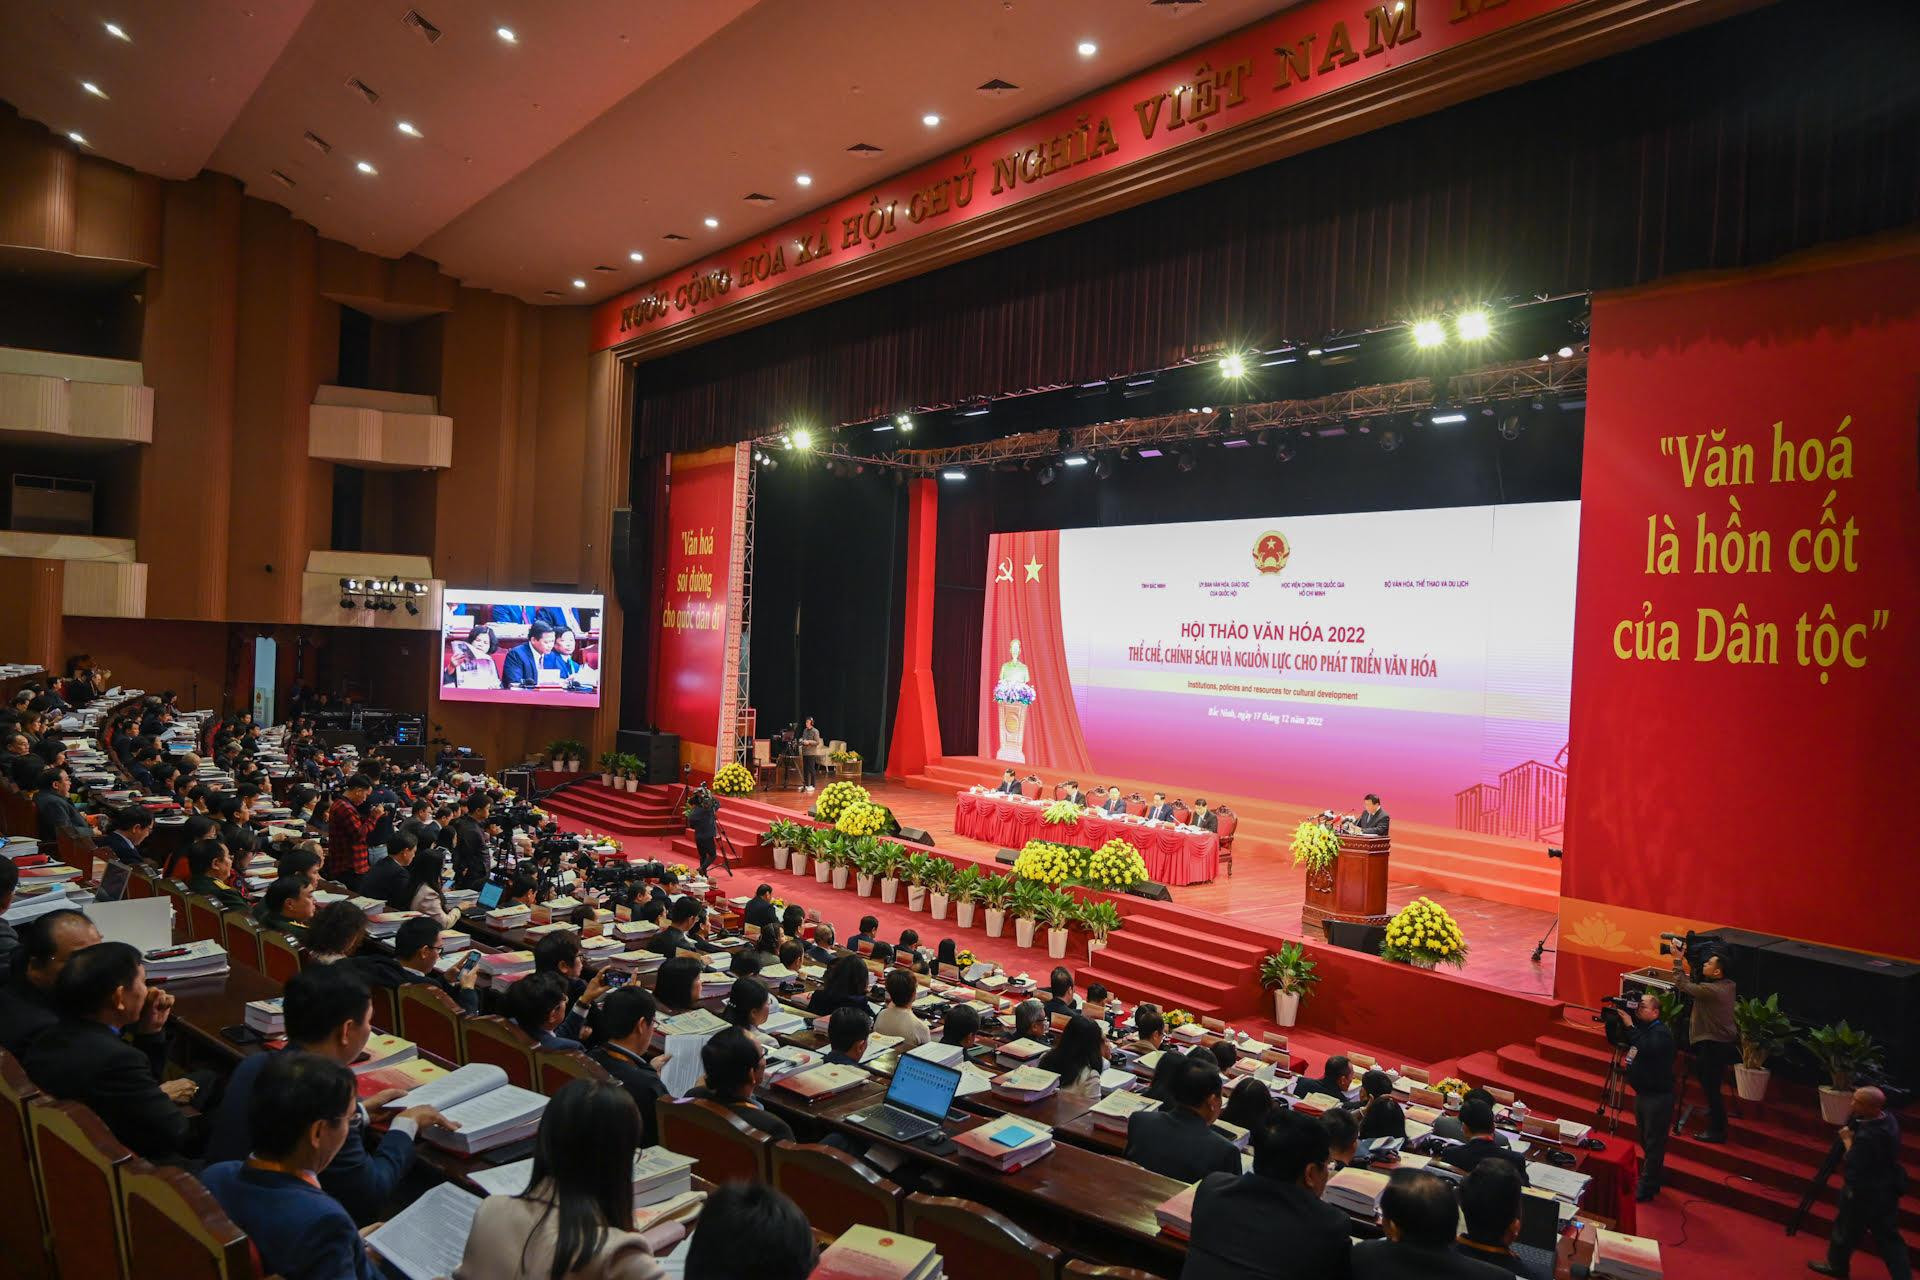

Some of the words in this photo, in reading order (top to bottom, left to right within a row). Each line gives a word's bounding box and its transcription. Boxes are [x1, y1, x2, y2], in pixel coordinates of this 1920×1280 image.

[675, 269, 732, 315] CỘNG
[737, 243, 787, 288] HÒA
[794, 218, 833, 267] XÃ
[841, 193, 899, 250] HỘI
[906, 154, 977, 225] CHỦ
[990, 111, 1120, 196] NGHĨA
[1134, 60, 1252, 141] VIỆT
[1272, 0, 1423, 92] NAM
[1660, 428, 1755, 488] "Văn
[1770, 415, 1854, 483] hoá
[699, 526, 714, 555] hoá
[1644, 514, 1680, 575] là
[1694, 494, 1772, 574] hồn
[1788, 489, 1860, 573] cốt
[676, 566, 689, 593] soi
[1181, 620, 1205, 642] HỘI
[1208, 619, 1249, 640] THẢO
[1253, 621, 1284, 641] VĂN
[1289, 621, 1324, 642] HÓA
[1328, 626, 1365, 643] 2022
[1613, 600, 1680, 661] của
[1694, 602, 1779, 665] Dân
[1165, 644, 1193, 664] CHÍNH
[1195, 645, 1218, 666] SÁCH
[1221, 646, 1232, 667] VÀ
[1234, 644, 1269, 668] NGUỒN
[1272, 652, 1291, 674] LỰC
[1294, 654, 1318, 672] CHO
[1320, 650, 1348, 673] PHÁT
[1351, 648, 1381, 675] TRIỂN
[1384, 653, 1408, 676] VĂN
[1410, 653, 1437, 678] HÓA
[1219, 684, 1240, 692] policies
[1241, 685, 1252, 693] and
[1253, 687, 1282, 695] resources
[1283, 687, 1291, 695] for
[1293, 689, 1316, 697] cultural
[1317, 690, 1358, 700] development
[1254, 712, 1261, 721] 17
[1281, 714, 1289, 723] 12
[1306, 716, 1324, 726] 2022
